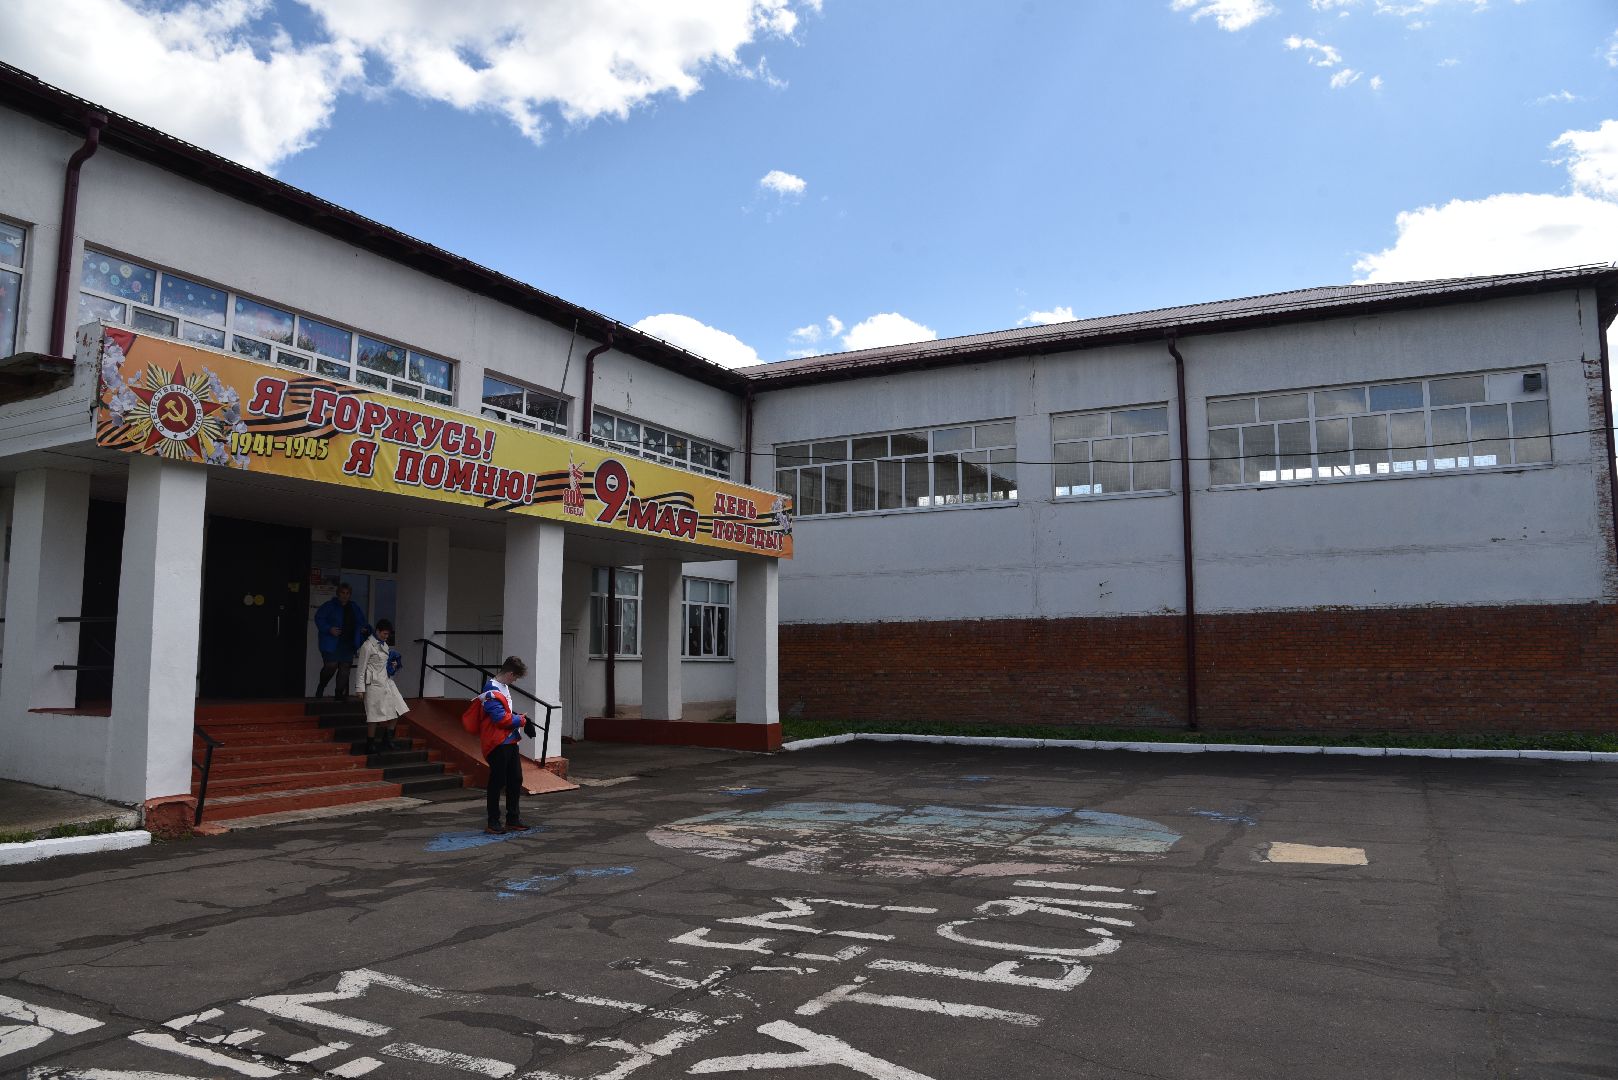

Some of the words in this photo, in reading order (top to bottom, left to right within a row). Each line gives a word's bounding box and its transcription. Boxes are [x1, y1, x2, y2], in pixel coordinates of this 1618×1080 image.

[151, 384, 200, 432] ОТЕЧЕСТВЕННАЯ
[248, 377, 288, 417] Я
[306, 386, 496, 462] ГОРЖУСЬ!
[231, 432, 329, 460] 1941-1945
[342, 439, 379, 477] Я
[394, 447, 537, 505] ПОМНЮ!
[593, 458, 631, 524] 9
[627, 496, 699, 541] МАЯ
[713, 492, 757, 520] ДЕНЬ
[712, 519, 784, 551] ПОБЕДЫ!
